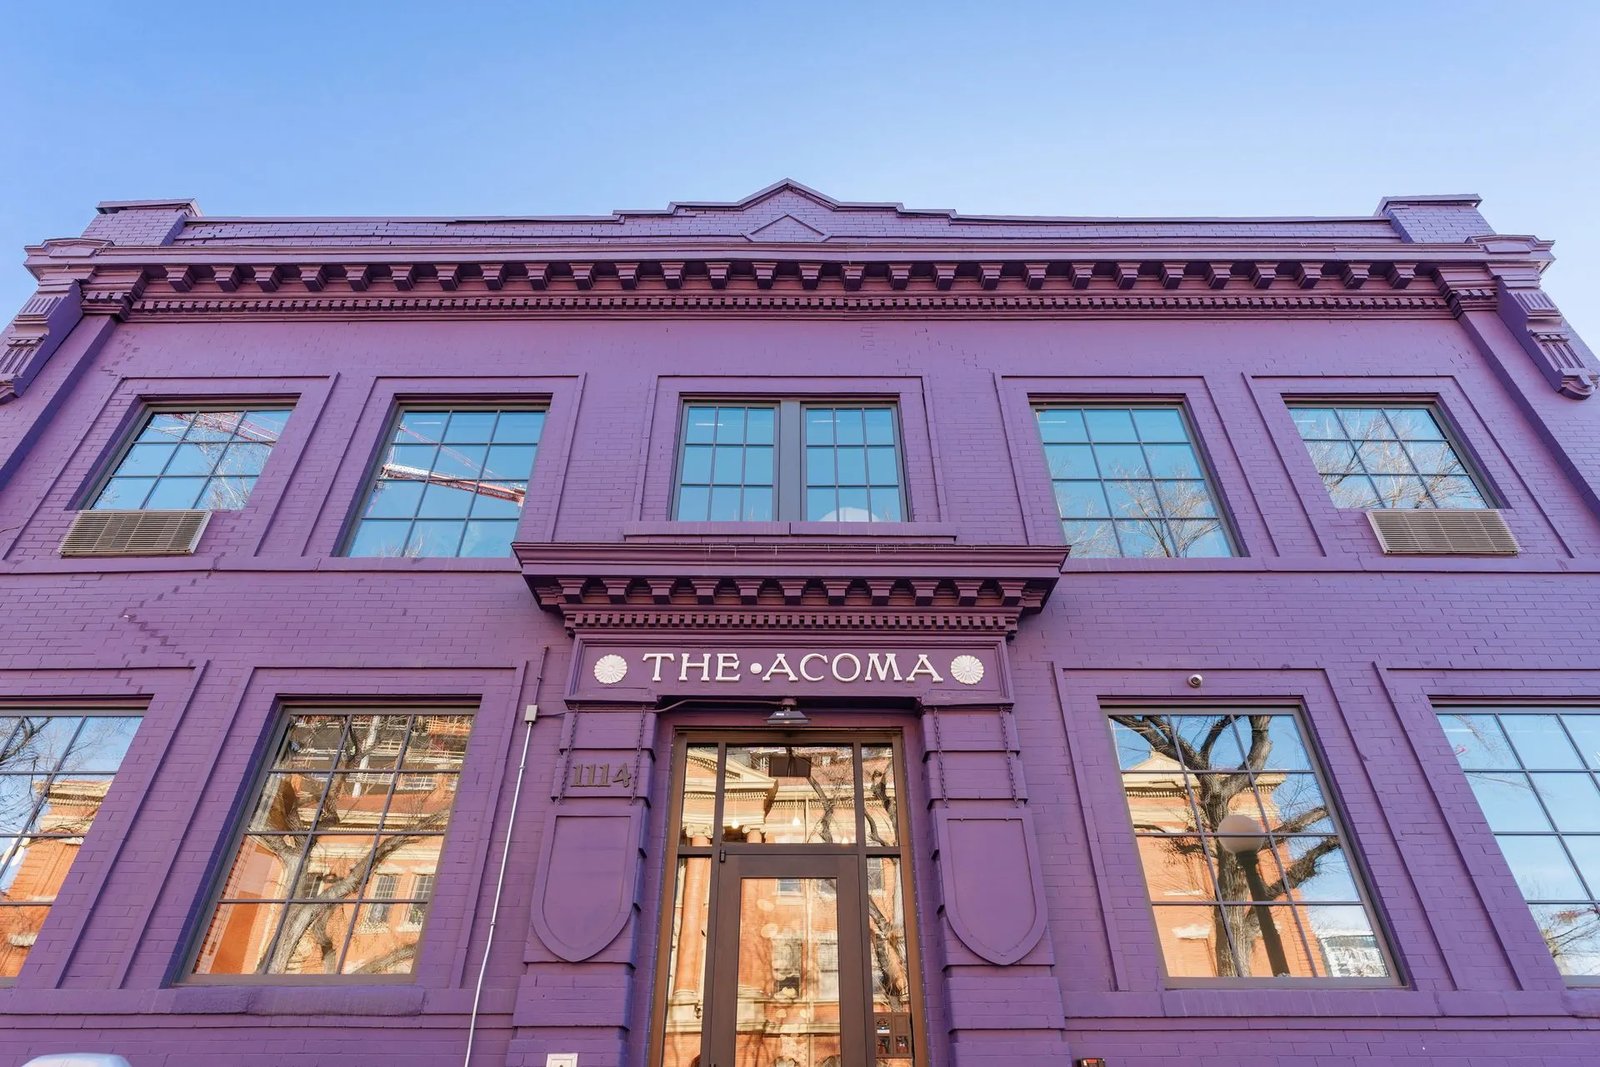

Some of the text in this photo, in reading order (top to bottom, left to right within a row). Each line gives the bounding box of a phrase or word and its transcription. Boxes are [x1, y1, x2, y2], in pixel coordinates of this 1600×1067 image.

[642, 653, 944, 683] THE ACOMA
[570, 763, 632, 788] 1114
